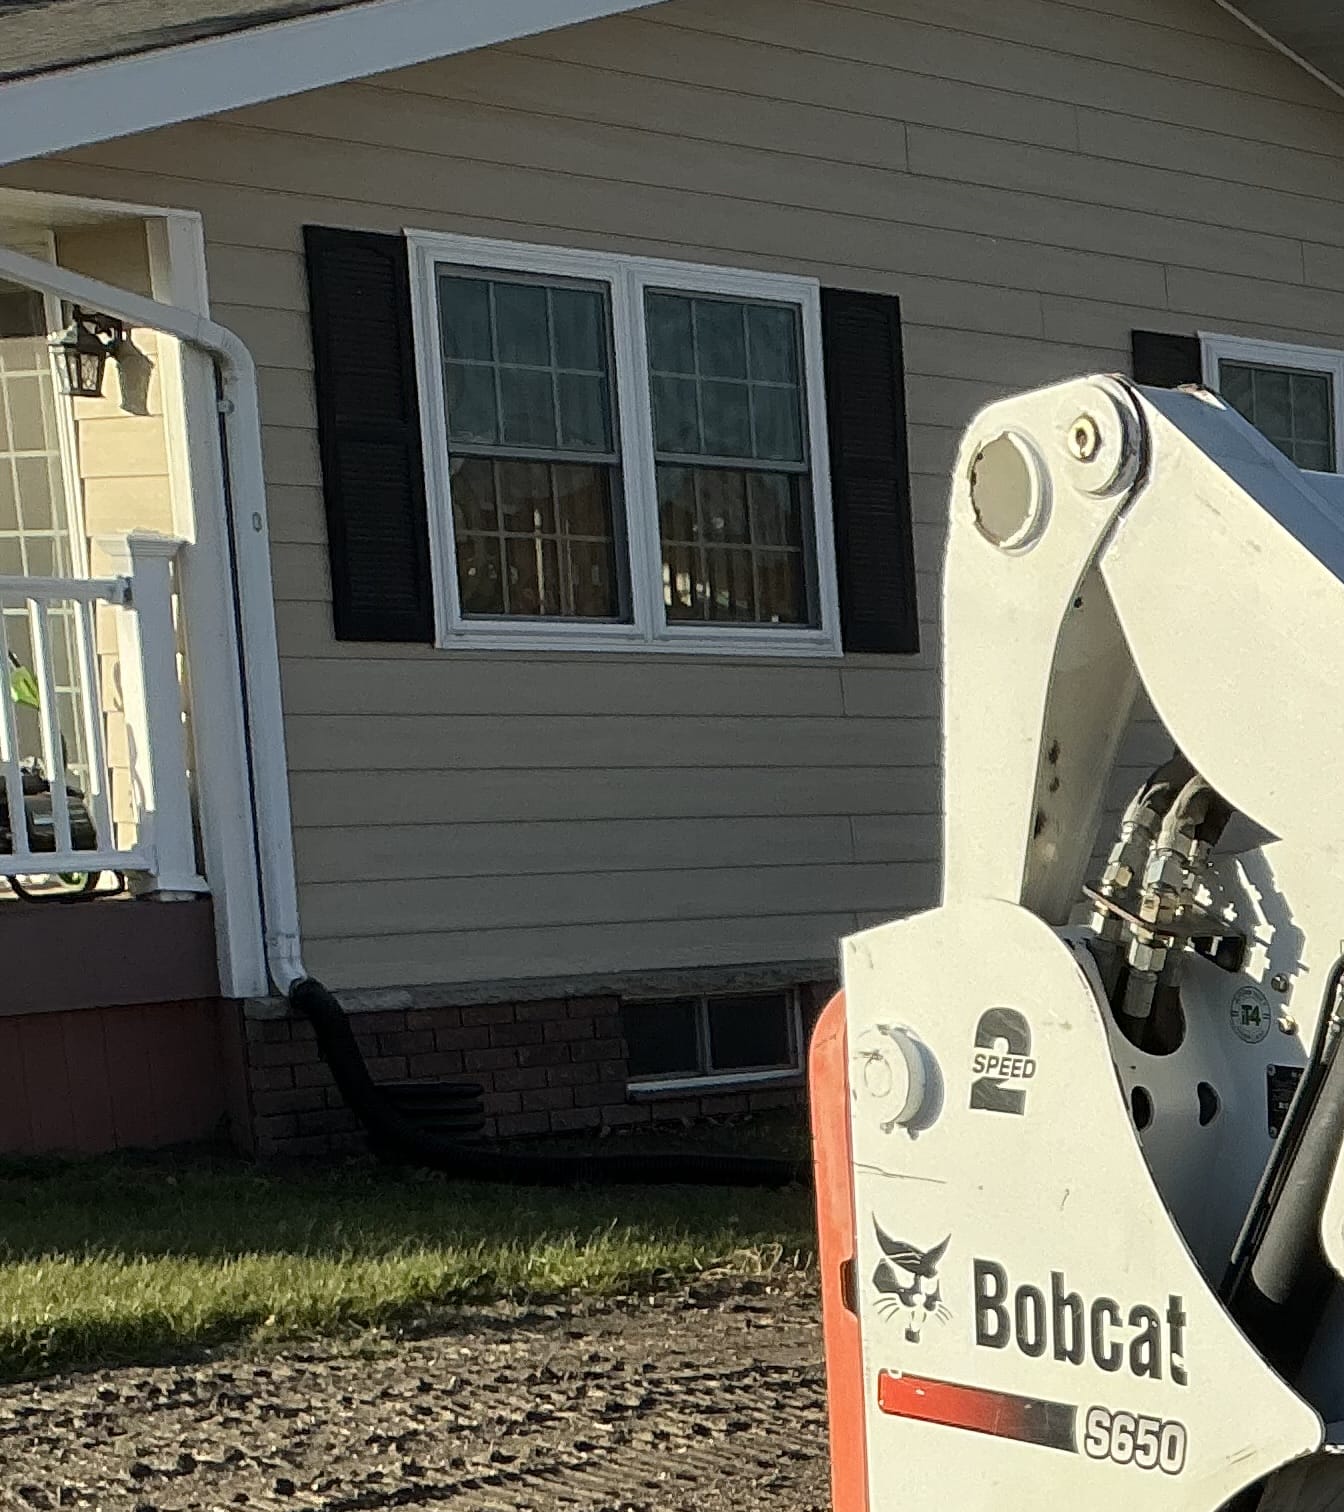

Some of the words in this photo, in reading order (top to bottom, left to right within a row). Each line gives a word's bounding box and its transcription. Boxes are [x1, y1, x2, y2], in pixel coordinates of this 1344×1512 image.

[972, 1053, 1037, 1080] SPEED
[972, 1257, 1189, 1387] Bobcat
[1084, 1405, 1189, 1475] S650
